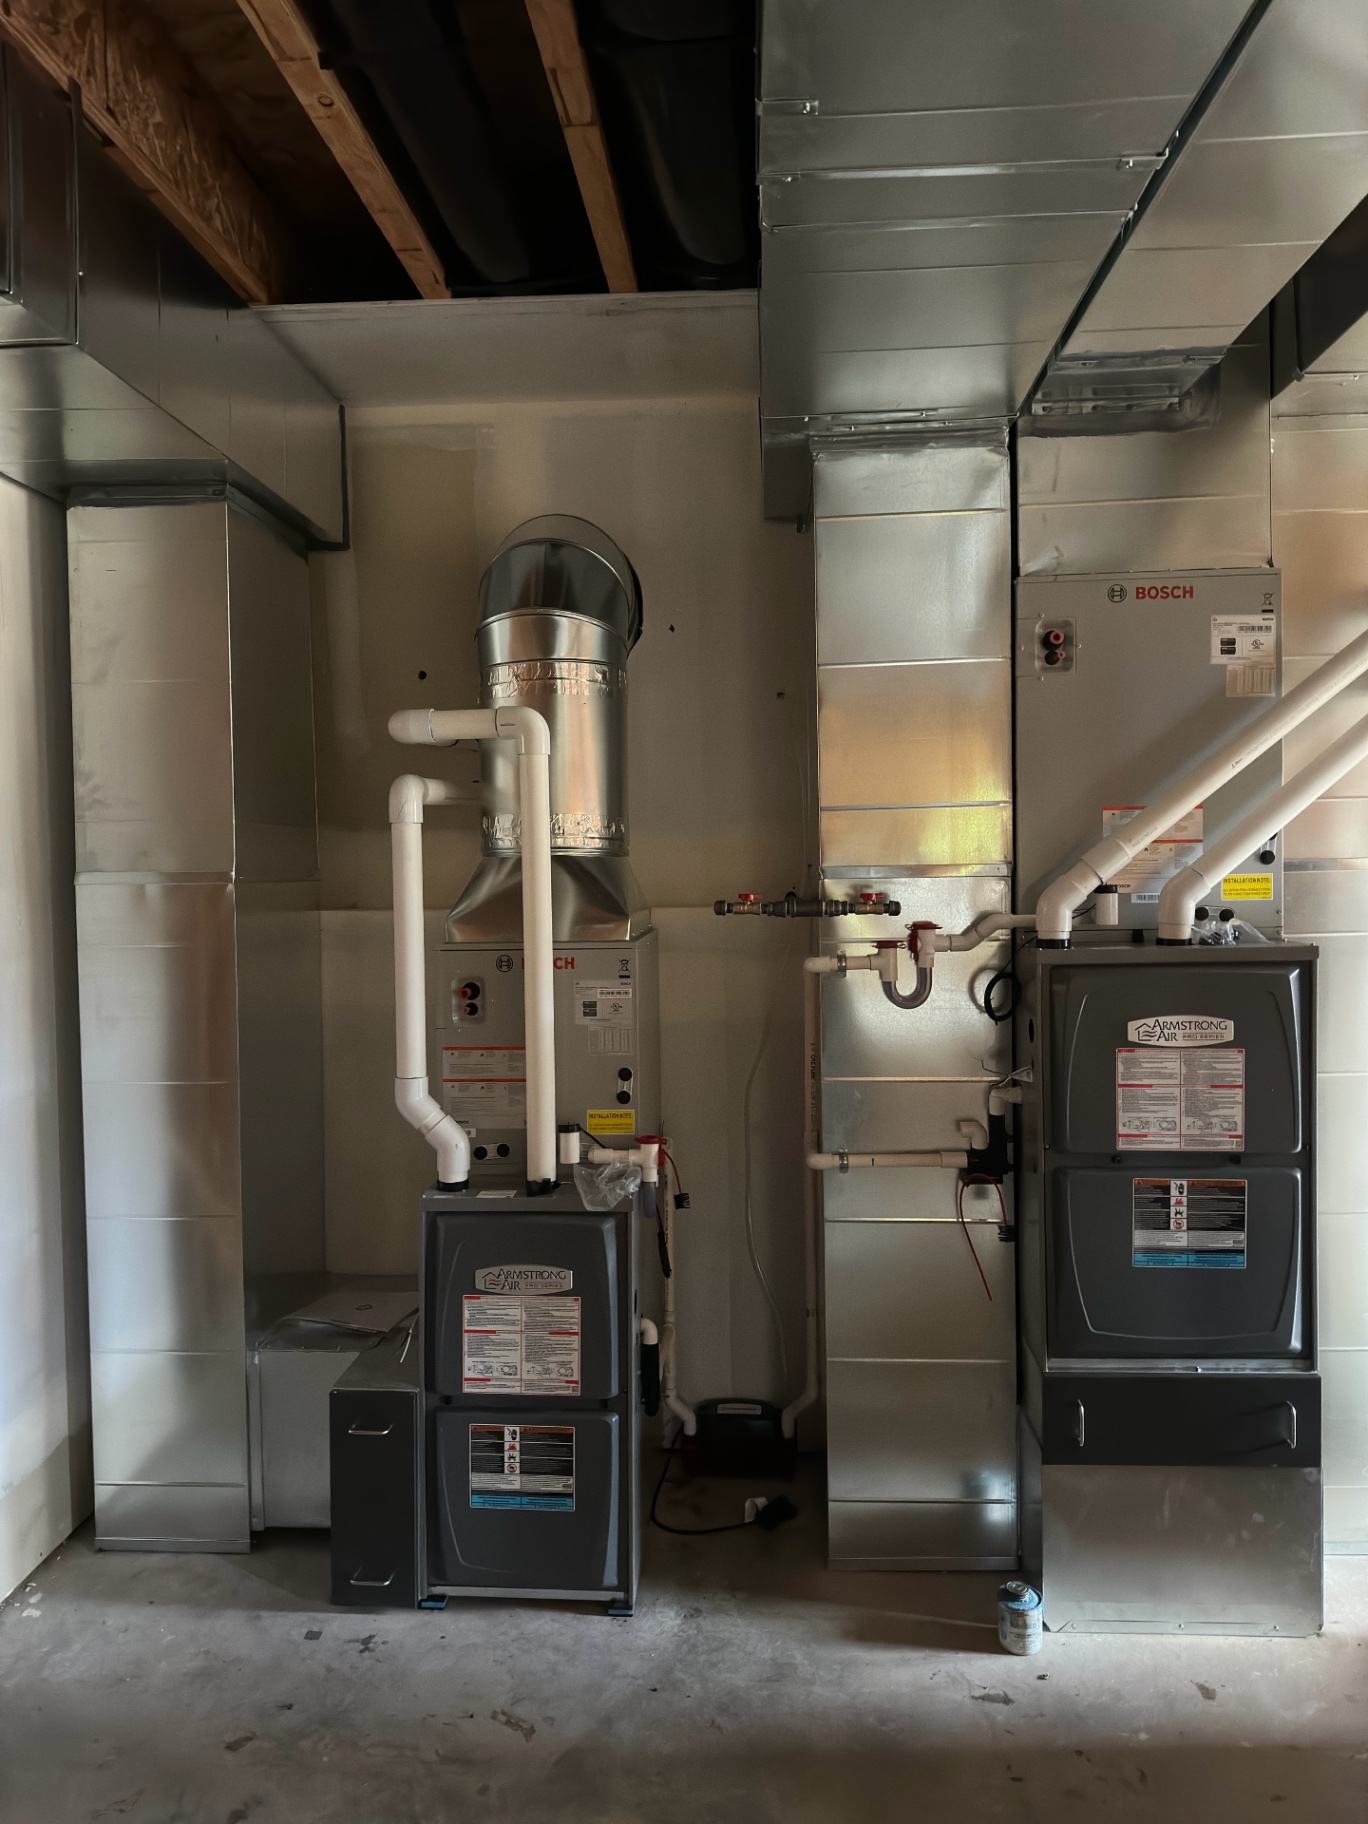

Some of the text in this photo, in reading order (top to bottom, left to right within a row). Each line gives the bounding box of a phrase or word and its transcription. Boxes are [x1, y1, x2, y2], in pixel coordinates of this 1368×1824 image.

[1135, 585, 1194, 600] BOSCH
[1151, 1018, 1228, 1031] ARMSTRONG
[1156, 1030, 1179, 1042] AIR
[496, 1268, 567, 1280] ARMSTRONG
[500, 1279, 522, 1291] AIR
